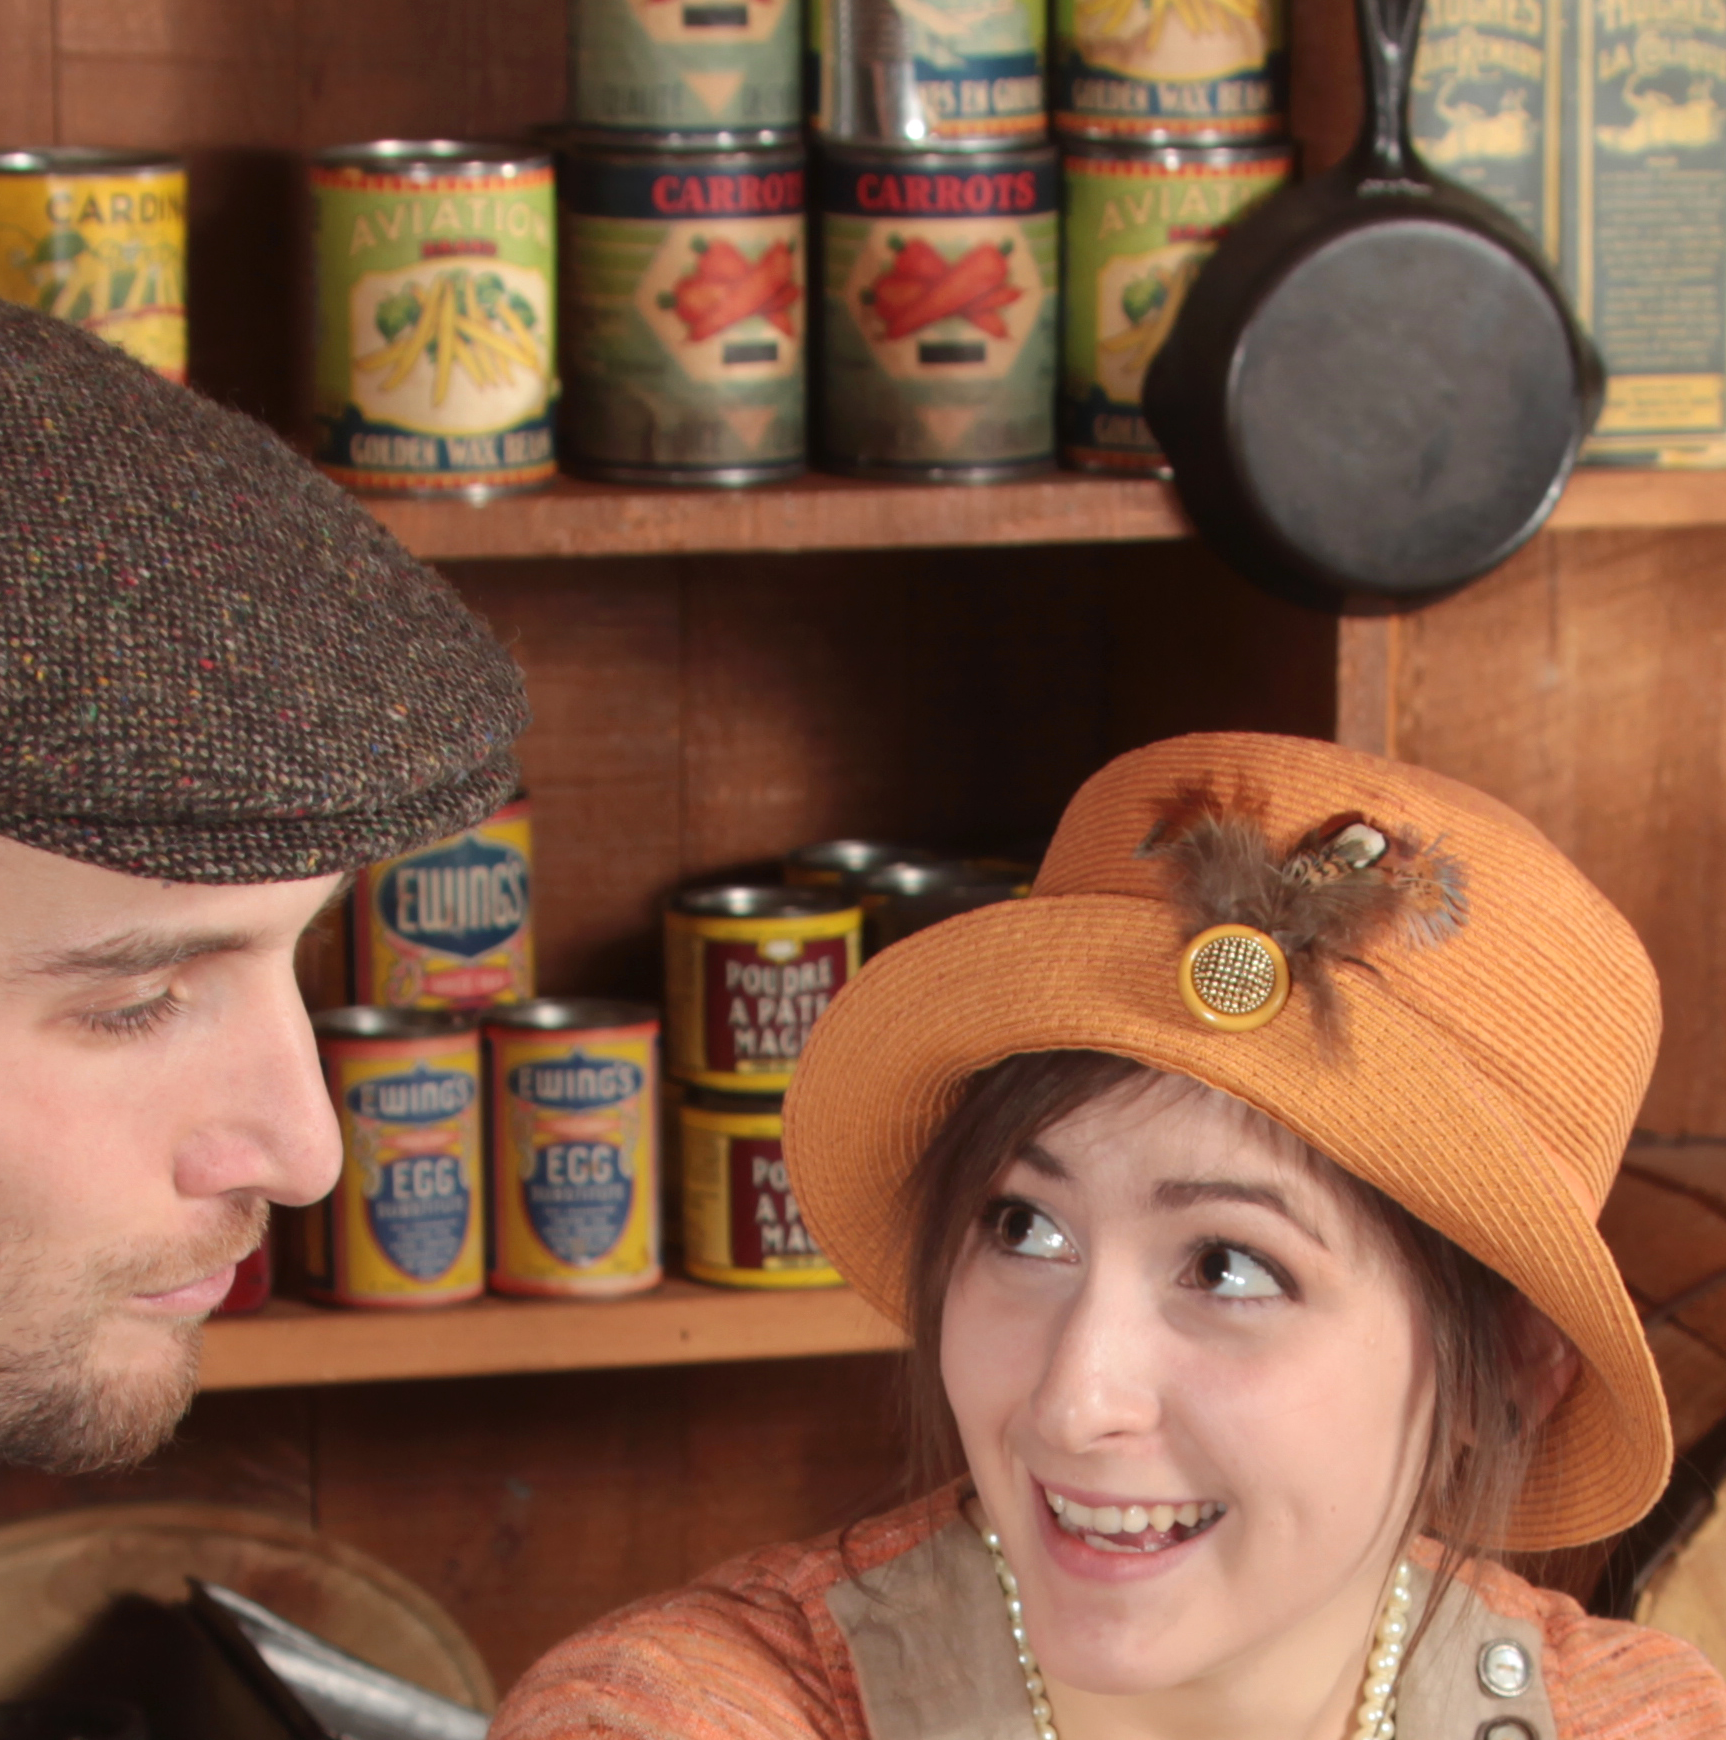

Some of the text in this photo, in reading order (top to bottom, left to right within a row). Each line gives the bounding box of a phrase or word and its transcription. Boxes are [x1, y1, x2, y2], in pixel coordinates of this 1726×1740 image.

[856, 171, 1037, 211] CARROTS
[725, 955, 833, 992] POUDRE
[733, 1026, 812, 1058] MAGI
[391, 1156, 457, 1199] EGG
[544, 1143, 615, 1185] EGG
